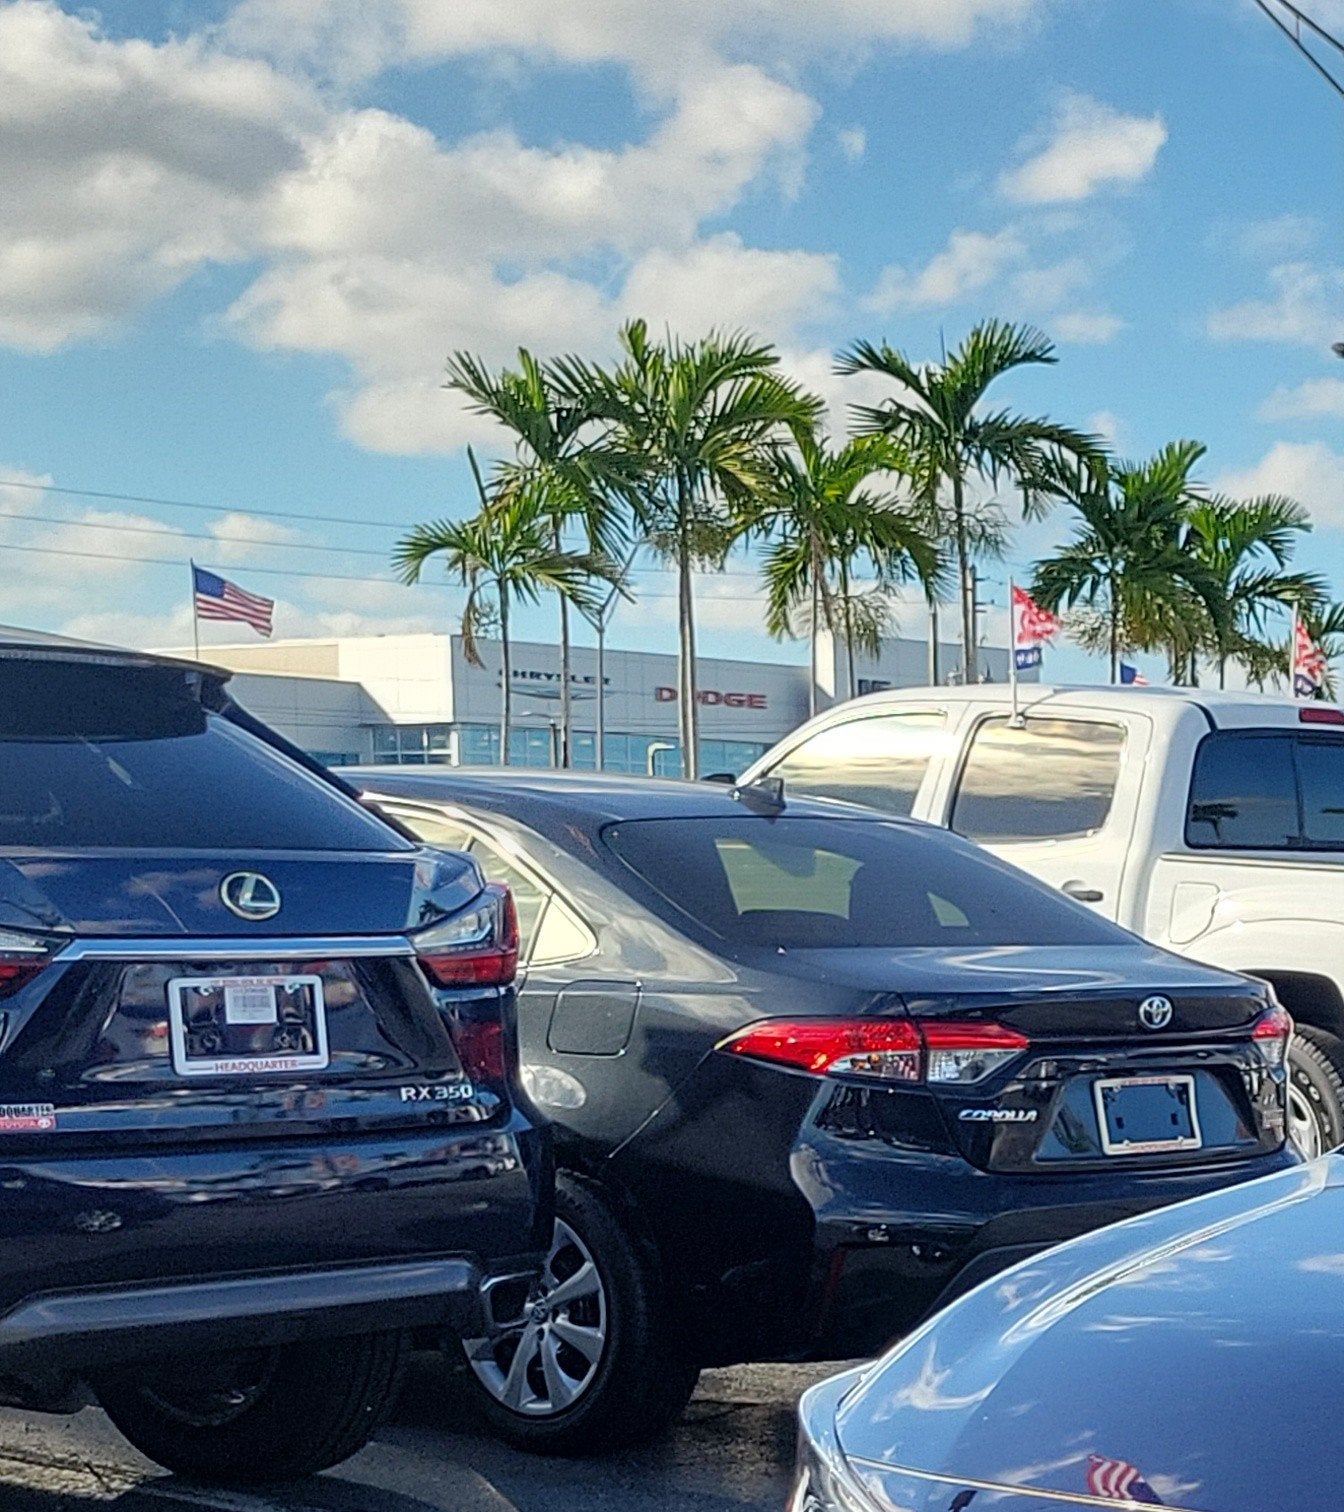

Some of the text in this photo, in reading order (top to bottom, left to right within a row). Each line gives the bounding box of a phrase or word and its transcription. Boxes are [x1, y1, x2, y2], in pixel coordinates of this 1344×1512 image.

[655, 687, 768, 709] DDGE
[214, 1059, 298, 1073] HEADQUARTER
[401, 1084, 473, 1101] RX 350
[958, 1109, 1038, 1122] COROLLA
